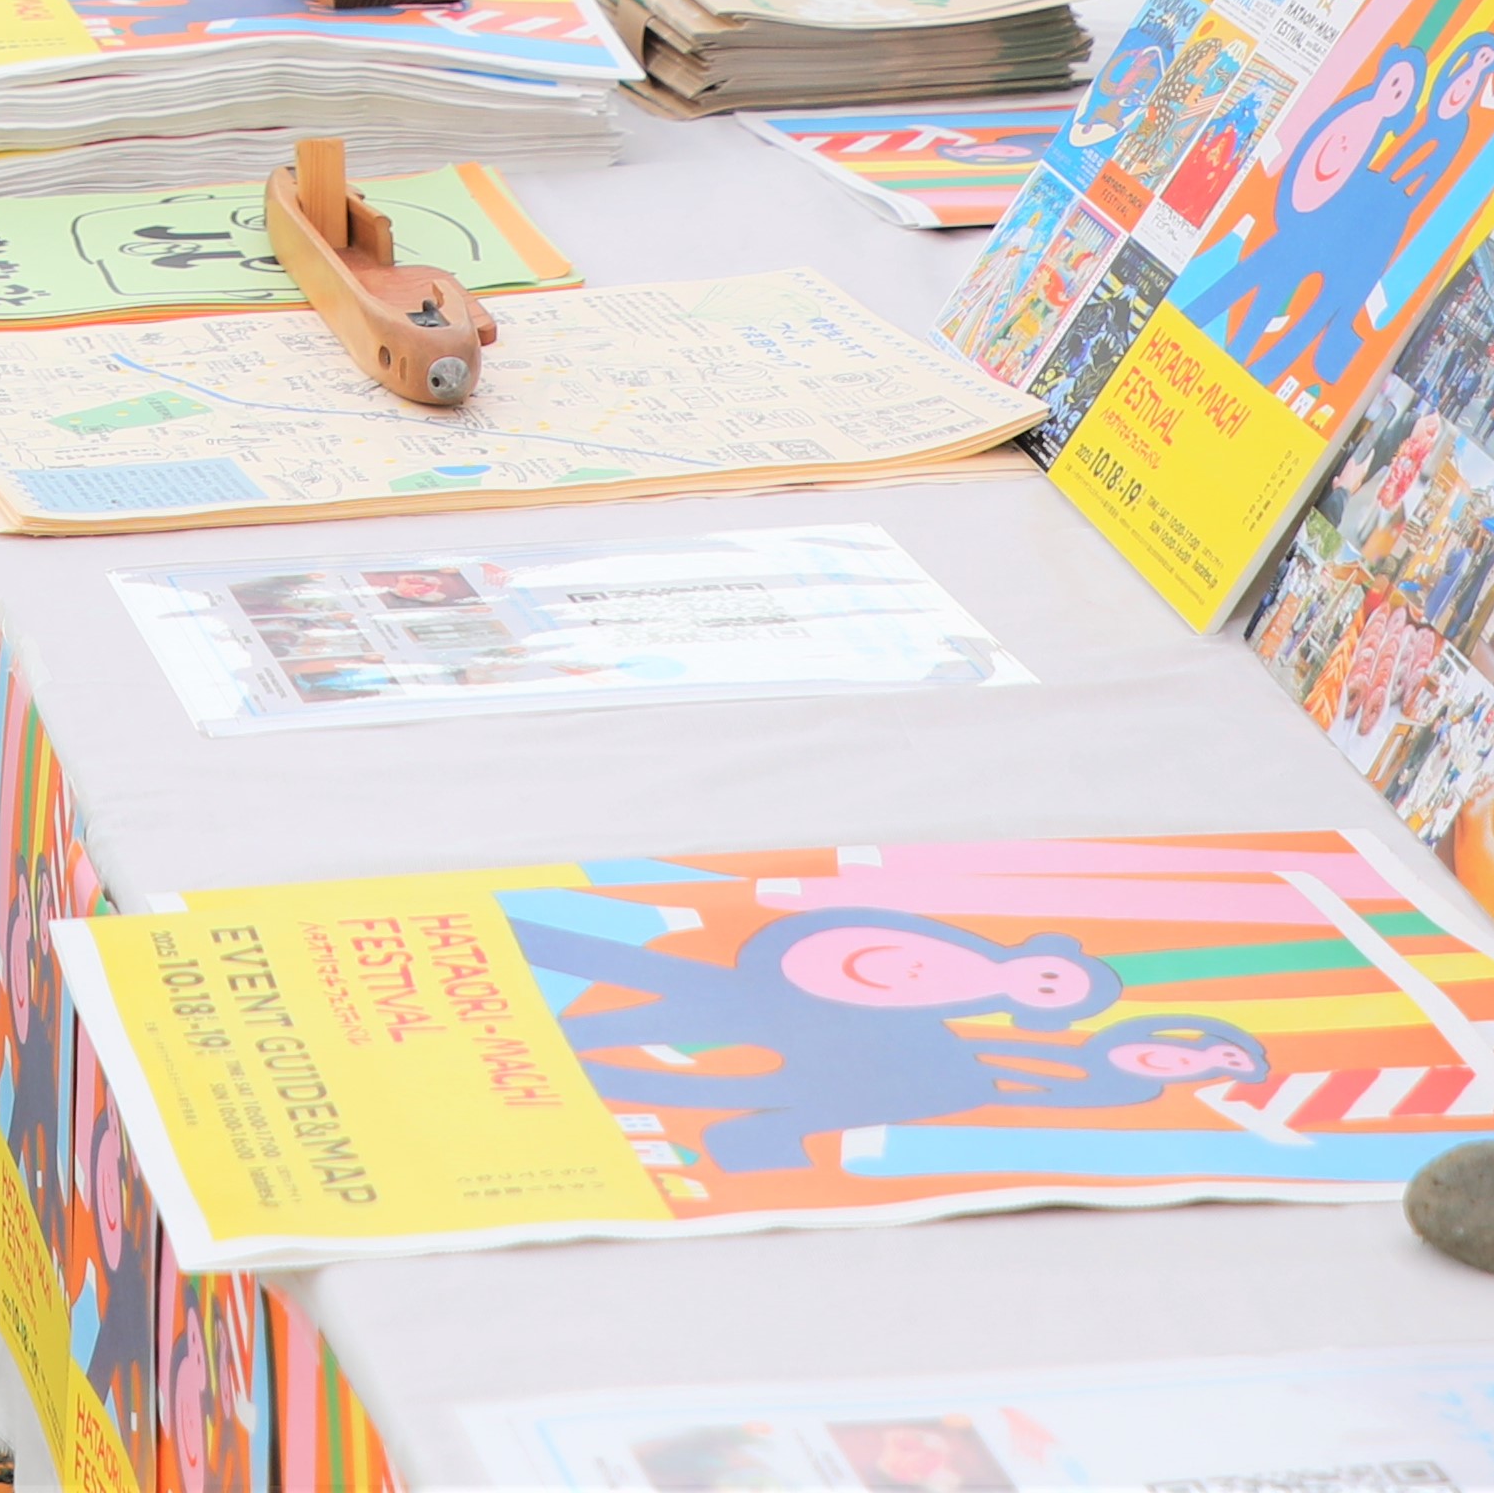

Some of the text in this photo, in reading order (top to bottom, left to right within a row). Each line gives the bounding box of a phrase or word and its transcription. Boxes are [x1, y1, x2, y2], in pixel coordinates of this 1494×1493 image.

[1271, 17, 1304, 51] FESTIVAL
[1113, 365, 1185, 448] FESTIVAL
[1138, 326, 1252, 440] HATAORI-MACHI
[149, 928, 180, 960] 2025
[336, 916, 448, 1045] FESTIVAL
[209, 924, 380, 1207] EVENT GUIDE&MAP
[407, 913, 565, 1109] HATAORI-MACHI
[0, 1154, 55, 1314] HATAORI-MACHI
[0, 1206, 38, 1309] FESTIVAL
